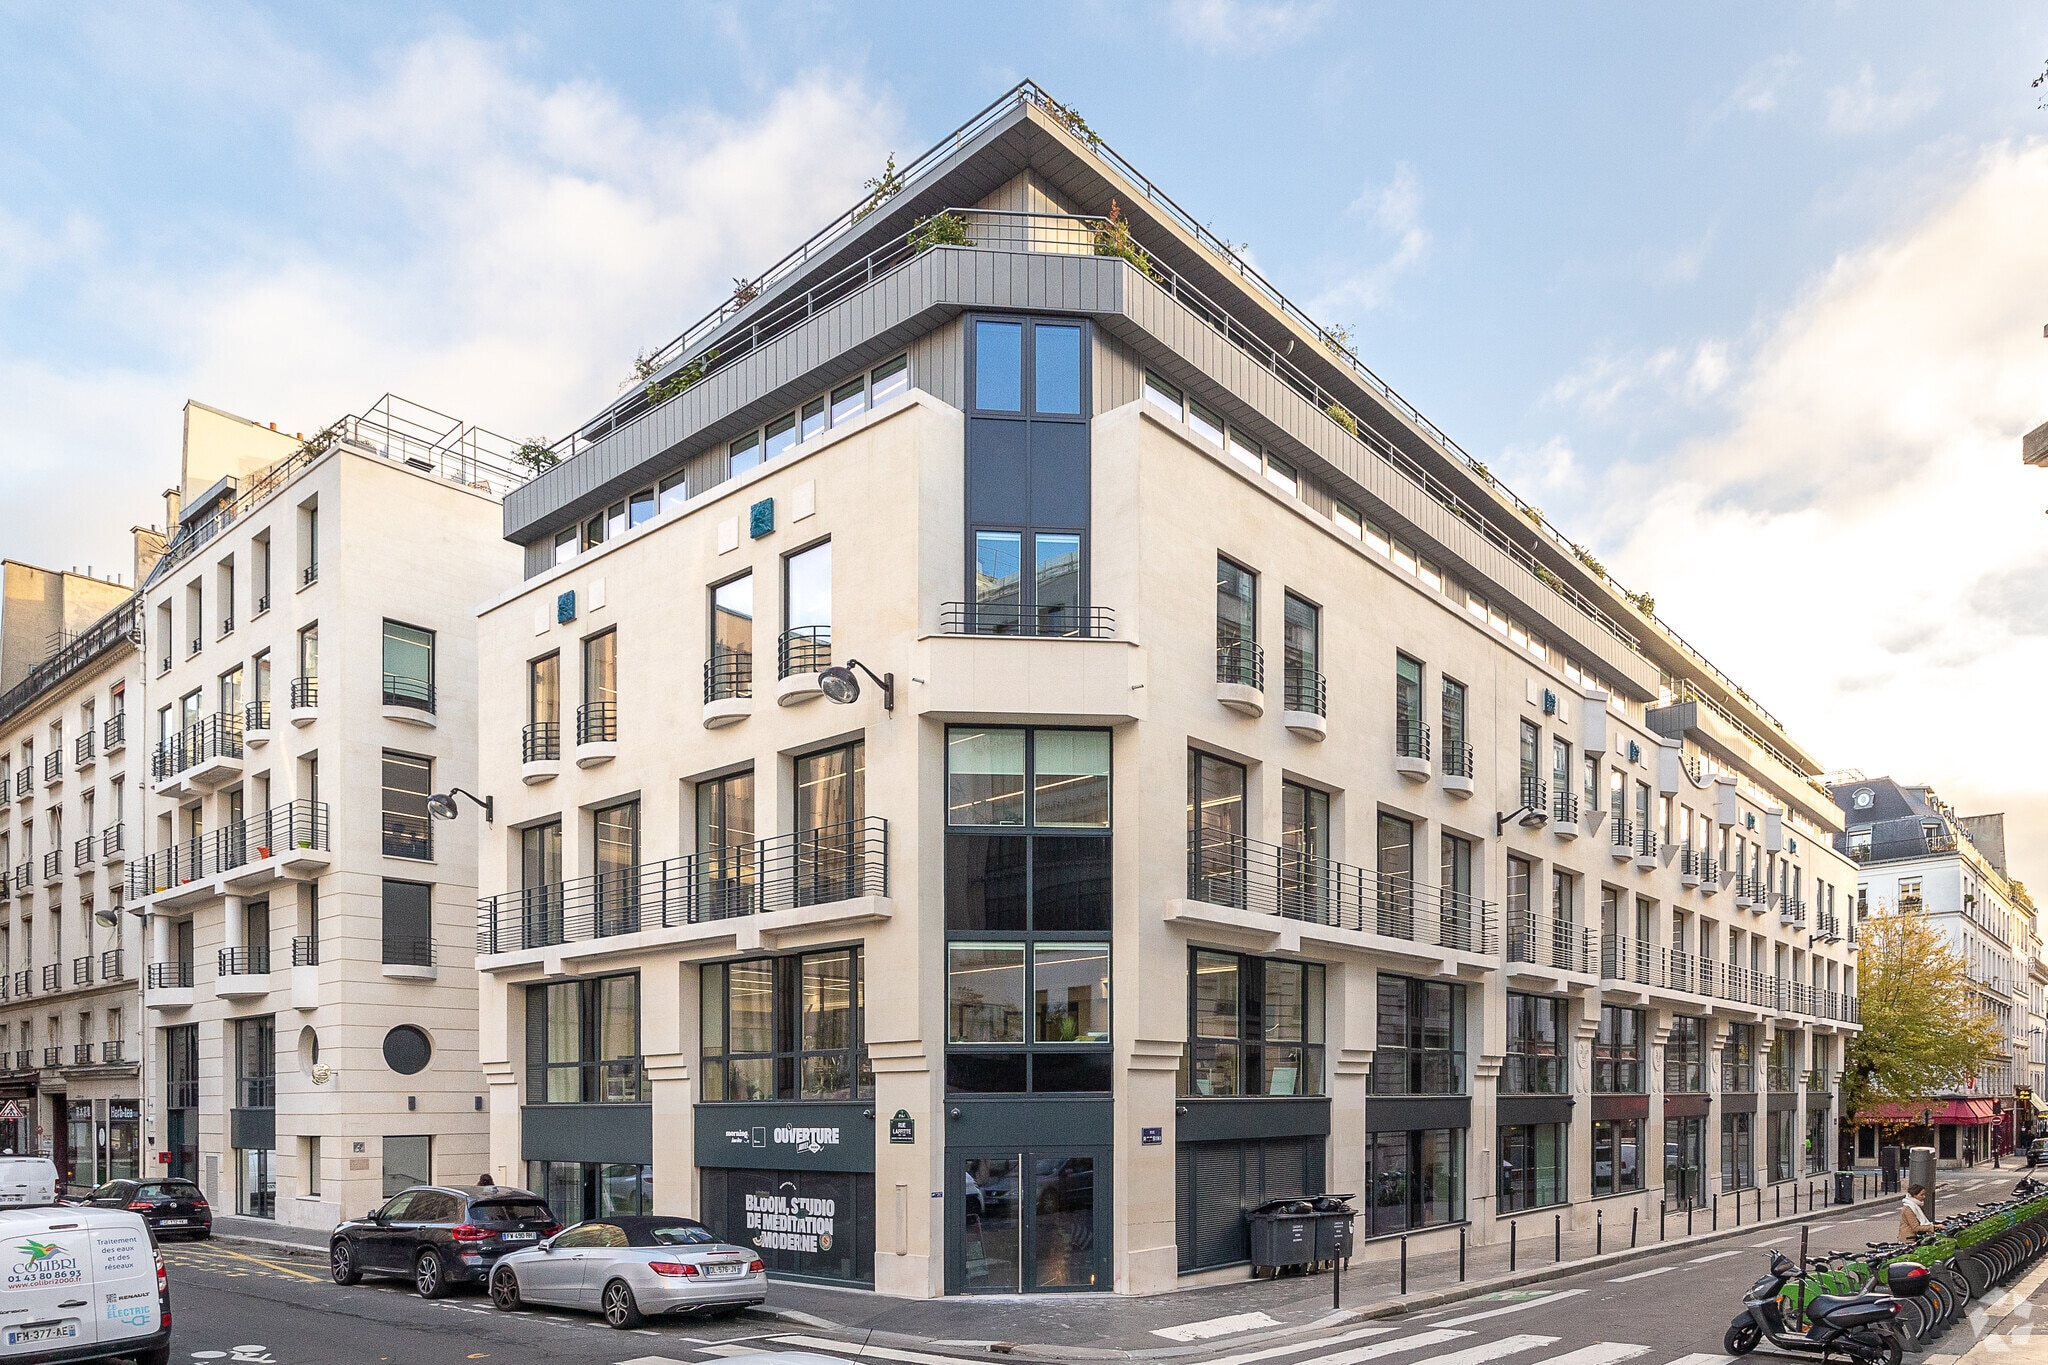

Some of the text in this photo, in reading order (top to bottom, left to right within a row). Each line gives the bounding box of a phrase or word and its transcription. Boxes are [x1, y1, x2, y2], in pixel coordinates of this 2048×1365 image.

[725, 1129, 748, 1139] morning
[773, 1127, 839, 1144] OUVERTURE
[791, 1197, 835, 1217] STUDIO
[746, 1212, 834, 1235] DE MEDITATION
[97, 1236, 137, 1246] Traitement
[761, 1230, 818, 1253] MODERNE
[12, 1258, 77, 1275] COLIBRI
[104, 1262, 134, 1271] réseaux
[8, 1275, 21, 1283] 01
[23, 1274, 37, 1282] 43
[39, 1272, 52, 1280] 80
[54, 1271, 67, 1279] 86
[8, 1276, 82, 1290] www.colibri2000.fr
[118, 1292, 150, 1301] RENAULT
